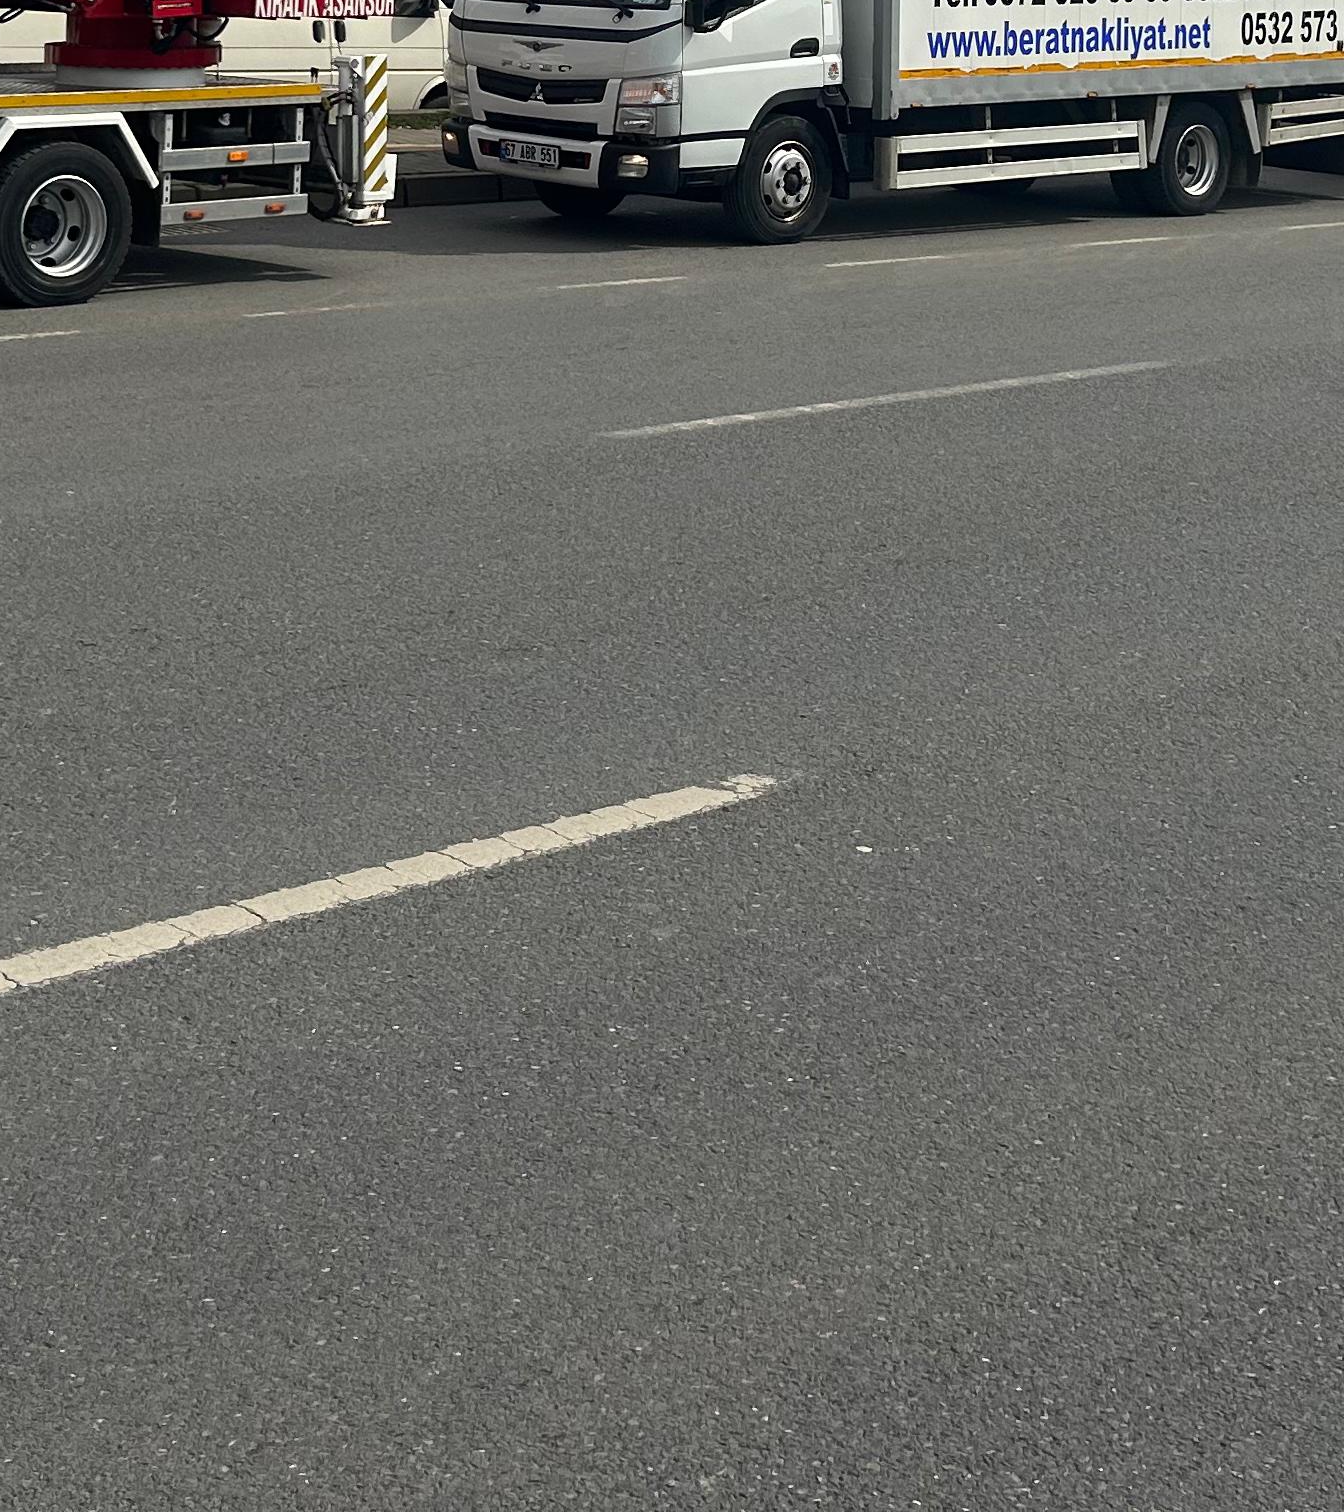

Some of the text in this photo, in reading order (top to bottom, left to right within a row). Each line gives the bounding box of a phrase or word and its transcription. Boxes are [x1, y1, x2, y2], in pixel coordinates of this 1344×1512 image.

[927, 15, 1212, 61] www.beratnakliyat.net
[1240, 9, 1294, 47] 0532
[1299, 9, 1338, 44] 573
[541, 147, 557, 163] 551
